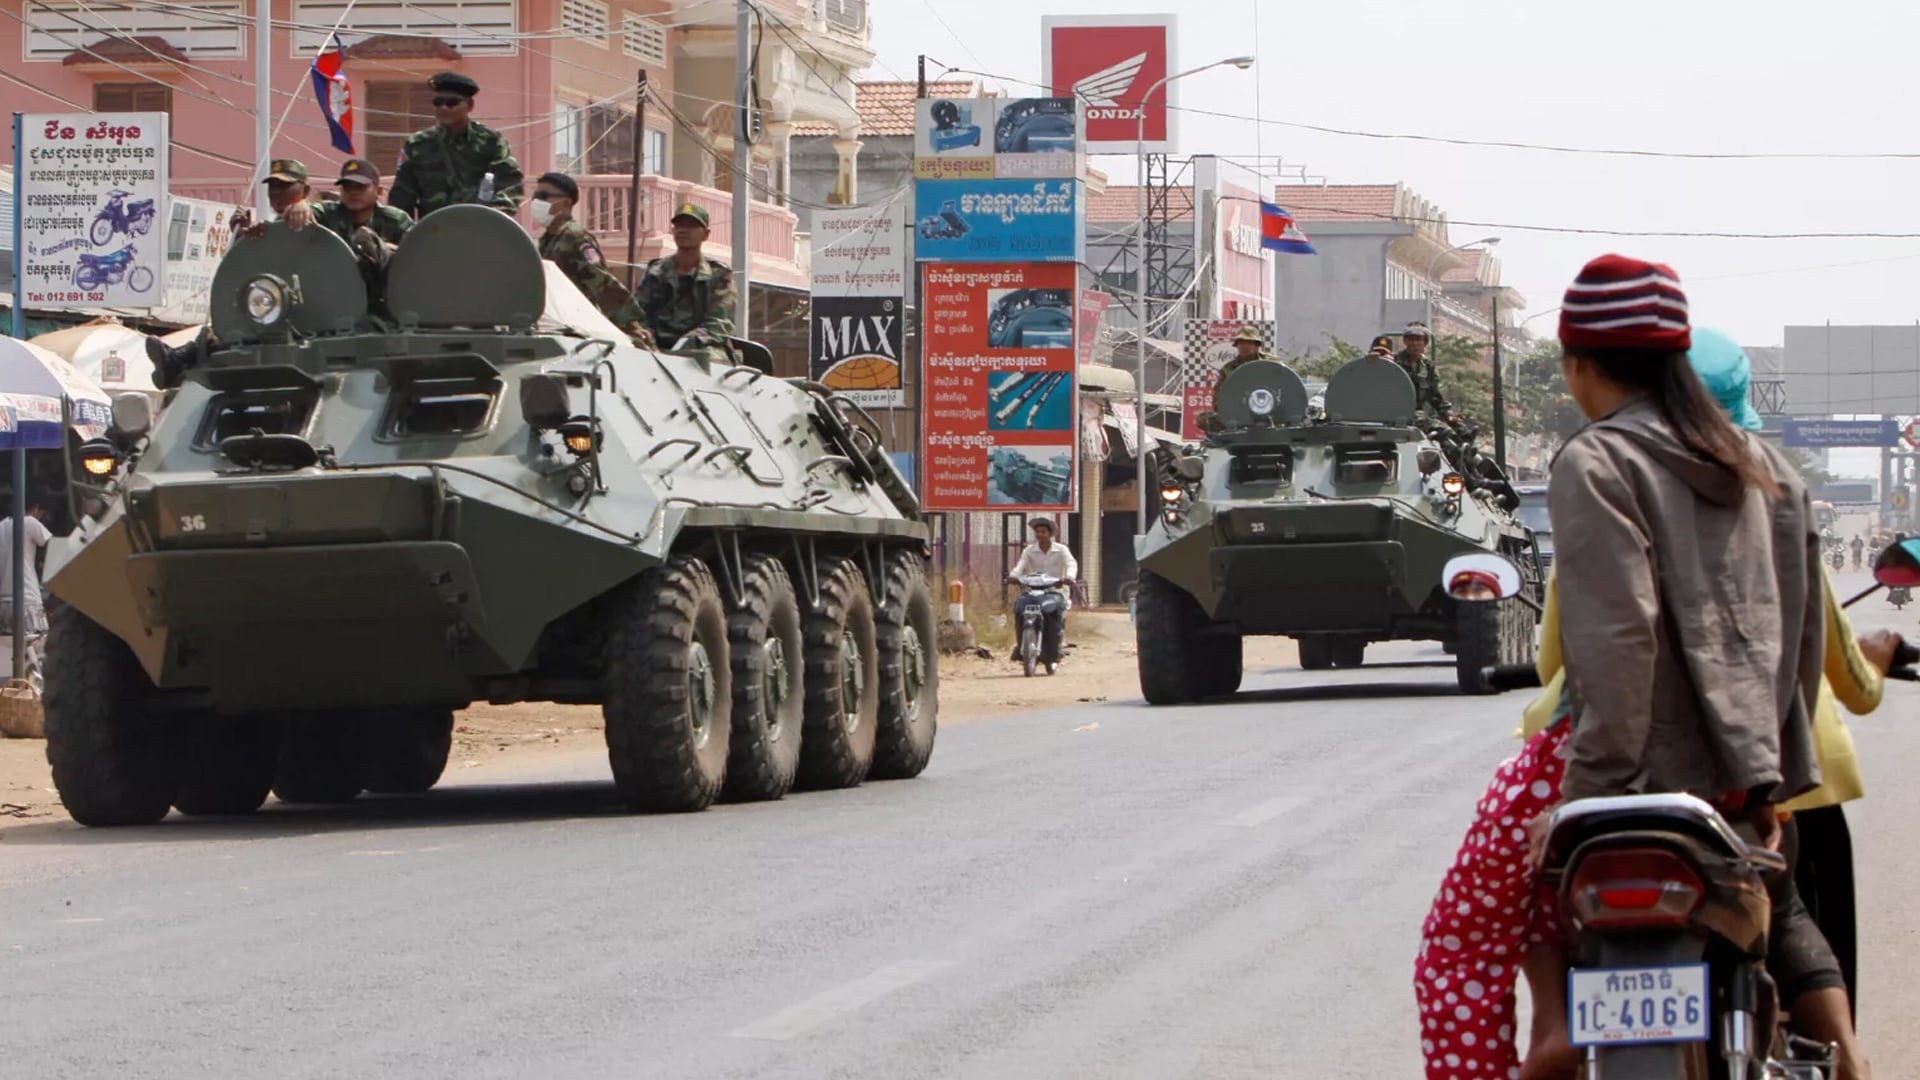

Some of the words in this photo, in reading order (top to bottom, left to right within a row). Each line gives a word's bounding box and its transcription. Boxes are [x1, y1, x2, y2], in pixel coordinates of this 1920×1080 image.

[1087, 108, 1147, 120] ONDA
[27, 292, 45, 301] Tel:
[47, 292, 65, 301] 012
[67, 292, 84, 301] 691
[87, 292, 104, 301] 502
[819, 315, 896, 361] MAX
[180, 514, 206, 532] 36
[1577, 995, 1699, 1031] 1C-4066
